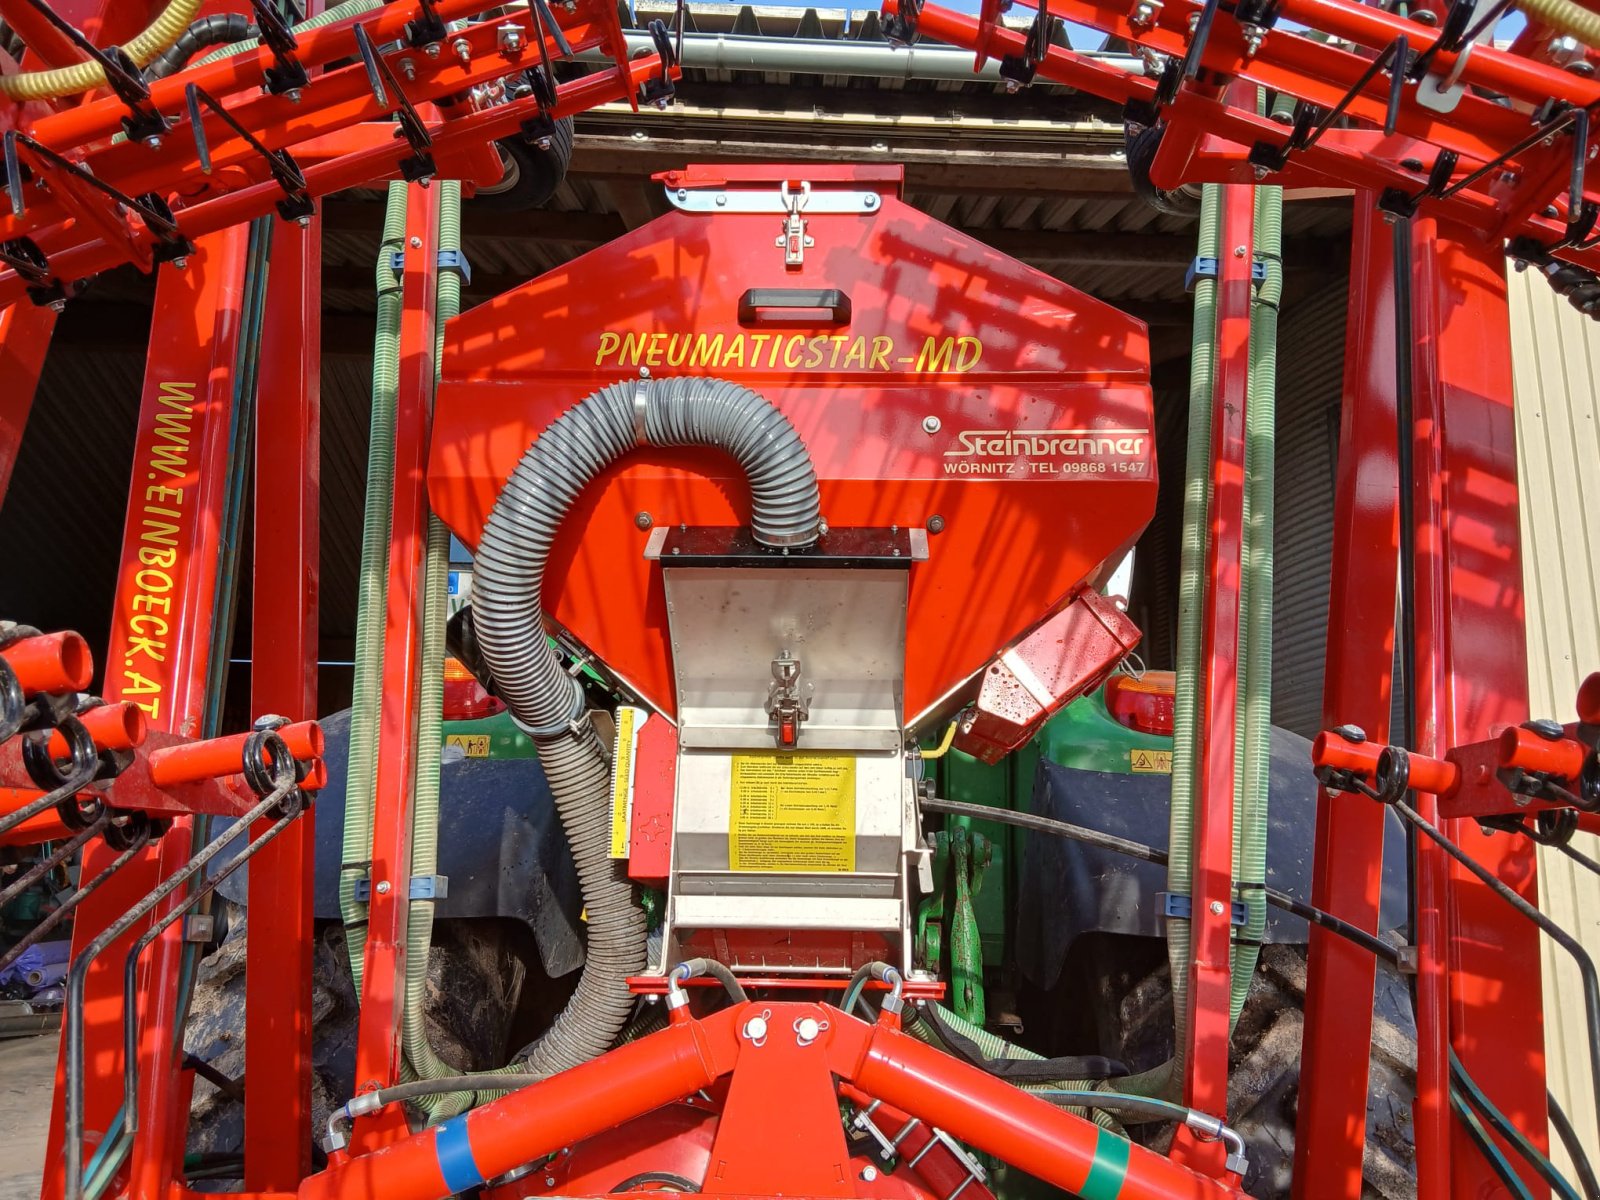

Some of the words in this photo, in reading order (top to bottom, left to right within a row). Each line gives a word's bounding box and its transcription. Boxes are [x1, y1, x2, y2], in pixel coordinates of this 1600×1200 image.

[943, 430, 1146, 456] Steinbrenner
[944, 460, 1015, 474] WÖRNITZ
[1029, 462, 1059, 473] TEL
[1063, 462, 1106, 473] 09868
[1112, 462, 1145, 473] 1547
[121, 382, 197, 720] WWW.EINBOECK.AT
